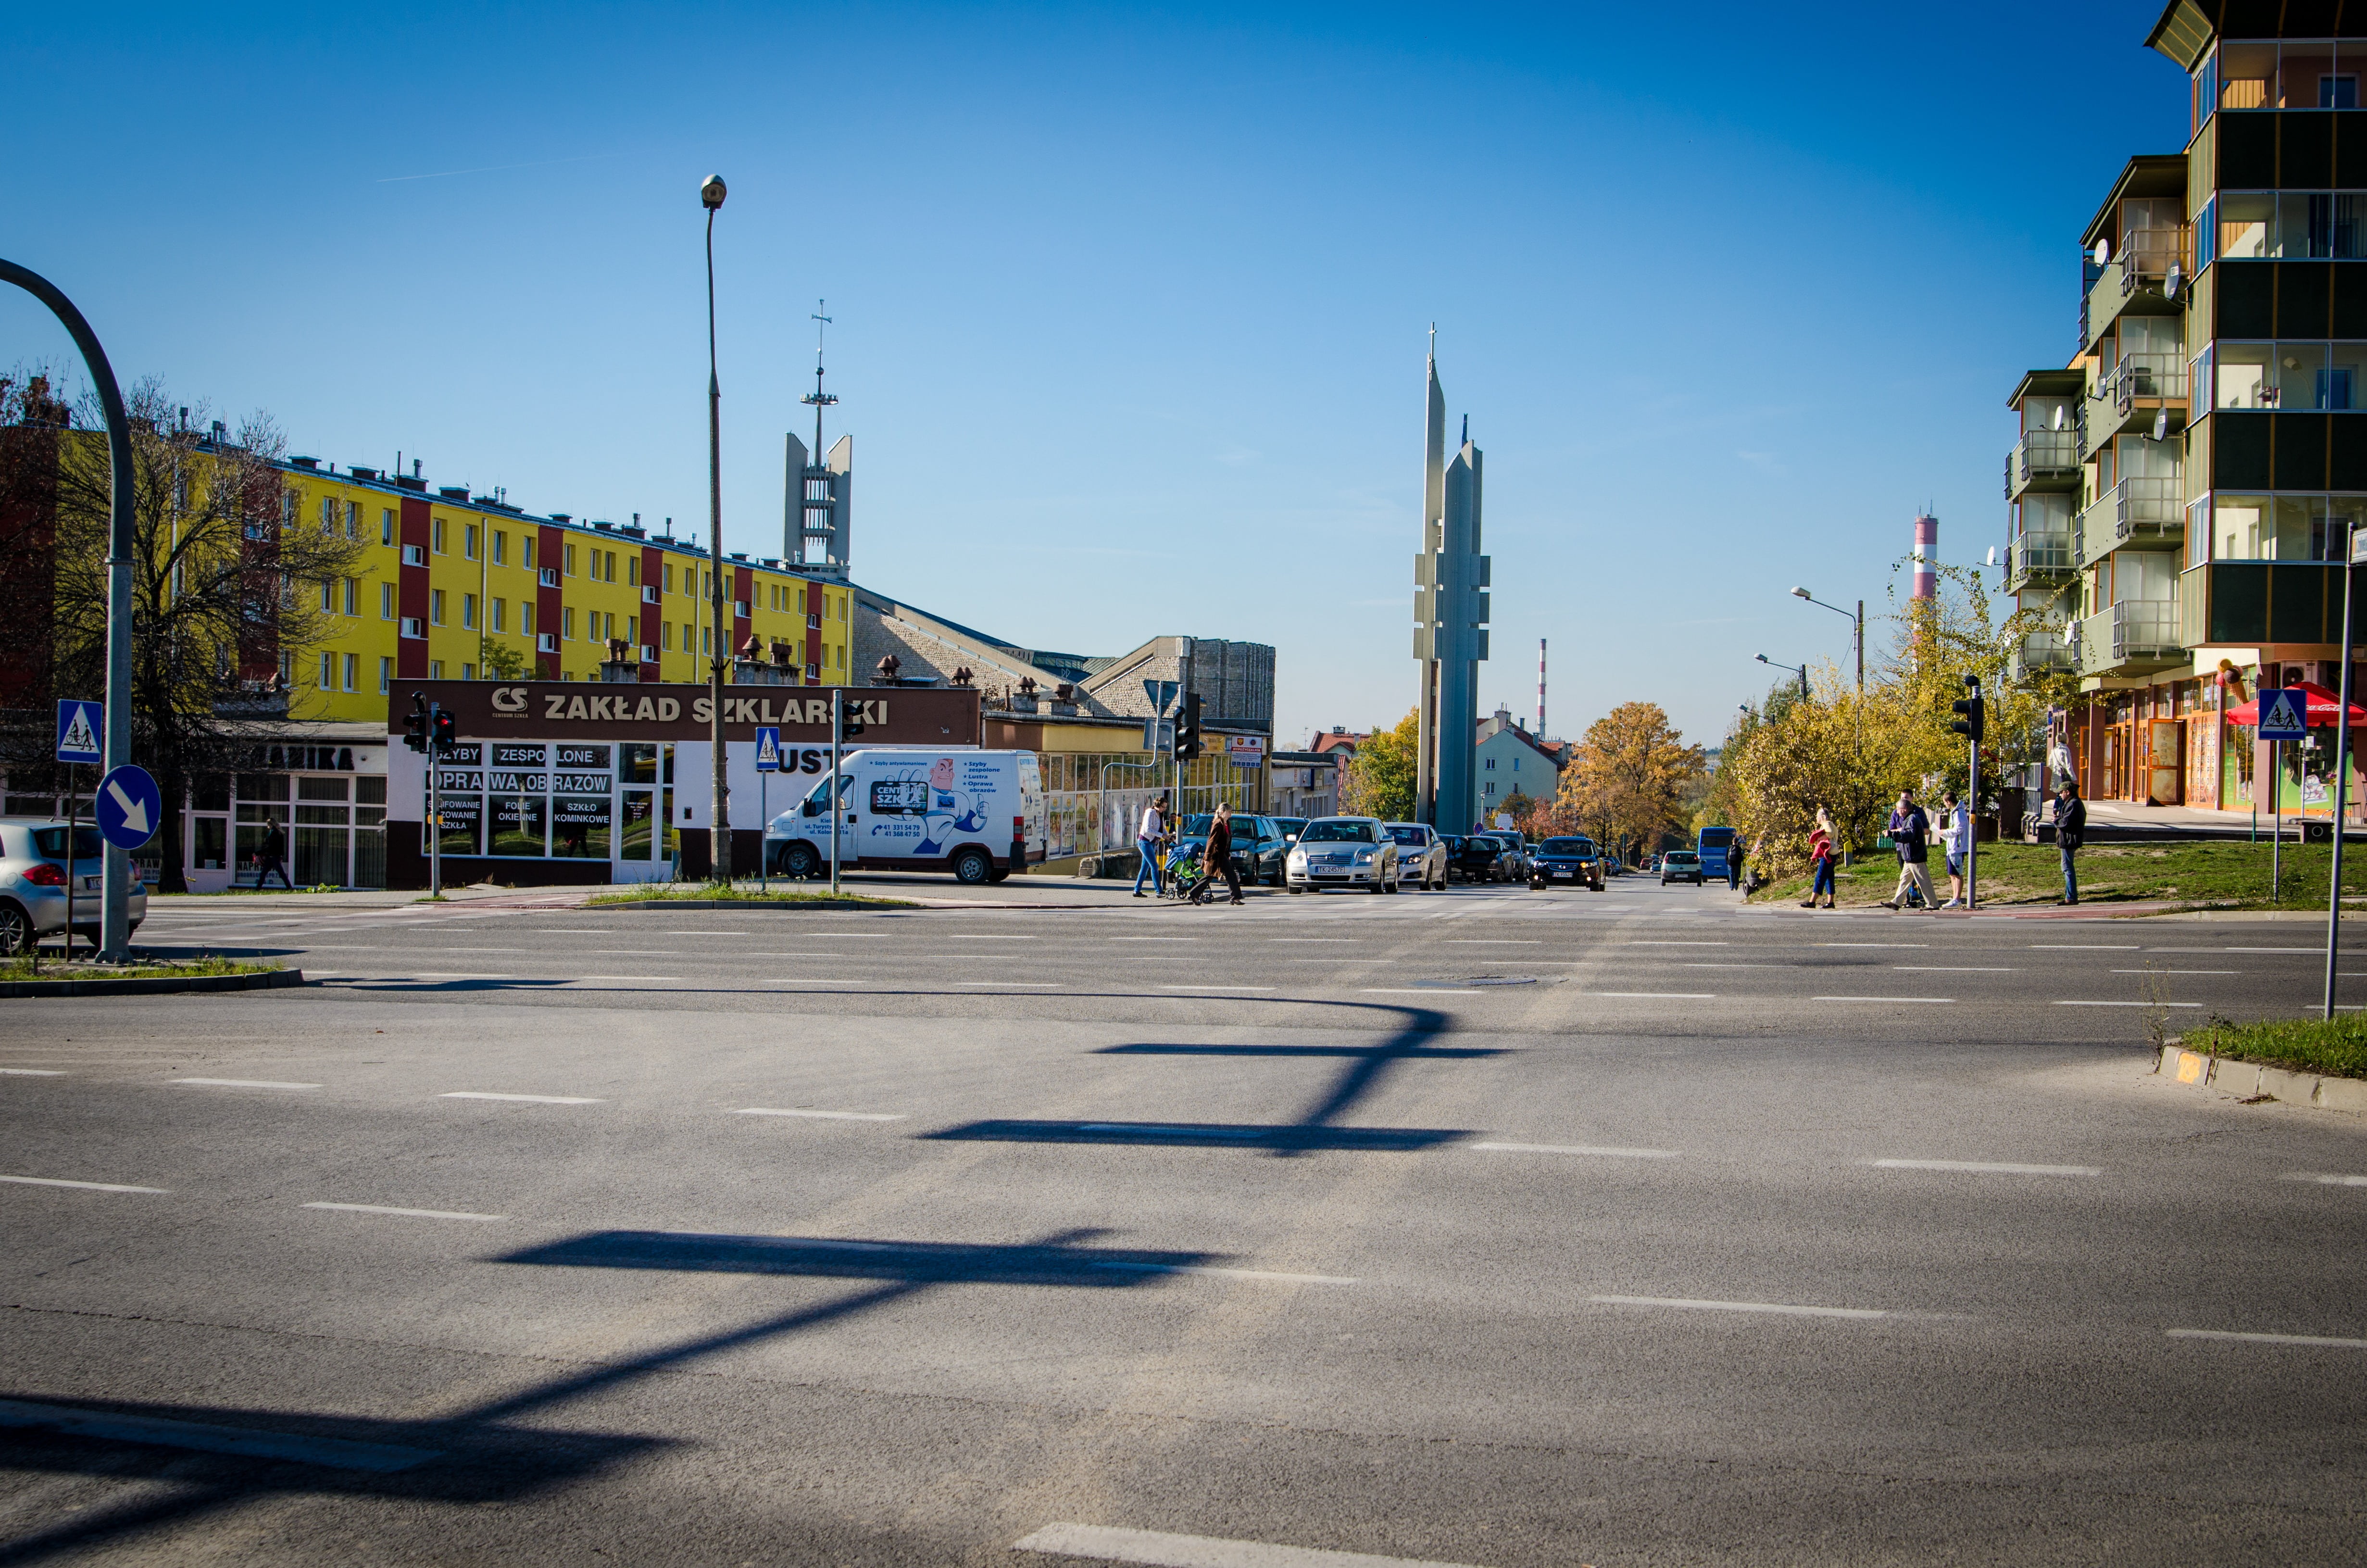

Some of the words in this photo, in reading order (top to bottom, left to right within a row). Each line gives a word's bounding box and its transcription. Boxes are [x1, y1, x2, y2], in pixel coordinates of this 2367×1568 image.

[491, 688, 528, 712] CS
[545, 695, 681, 721] ZAKŁAD
[692, 698, 888, 725] SZKLARKI
[501, 749, 593, 763] ZESPOLONE
[526, 774, 607, 791] OBRAZÓW
[427, 801, 480, 809] SLIFOWANIE
[505, 802, 531, 810] FOLIE
[567, 803, 597, 812] SZKŁO
[499, 813, 537, 821] OKIENNE
[554, 814, 609, 823] KOMINKOWE
